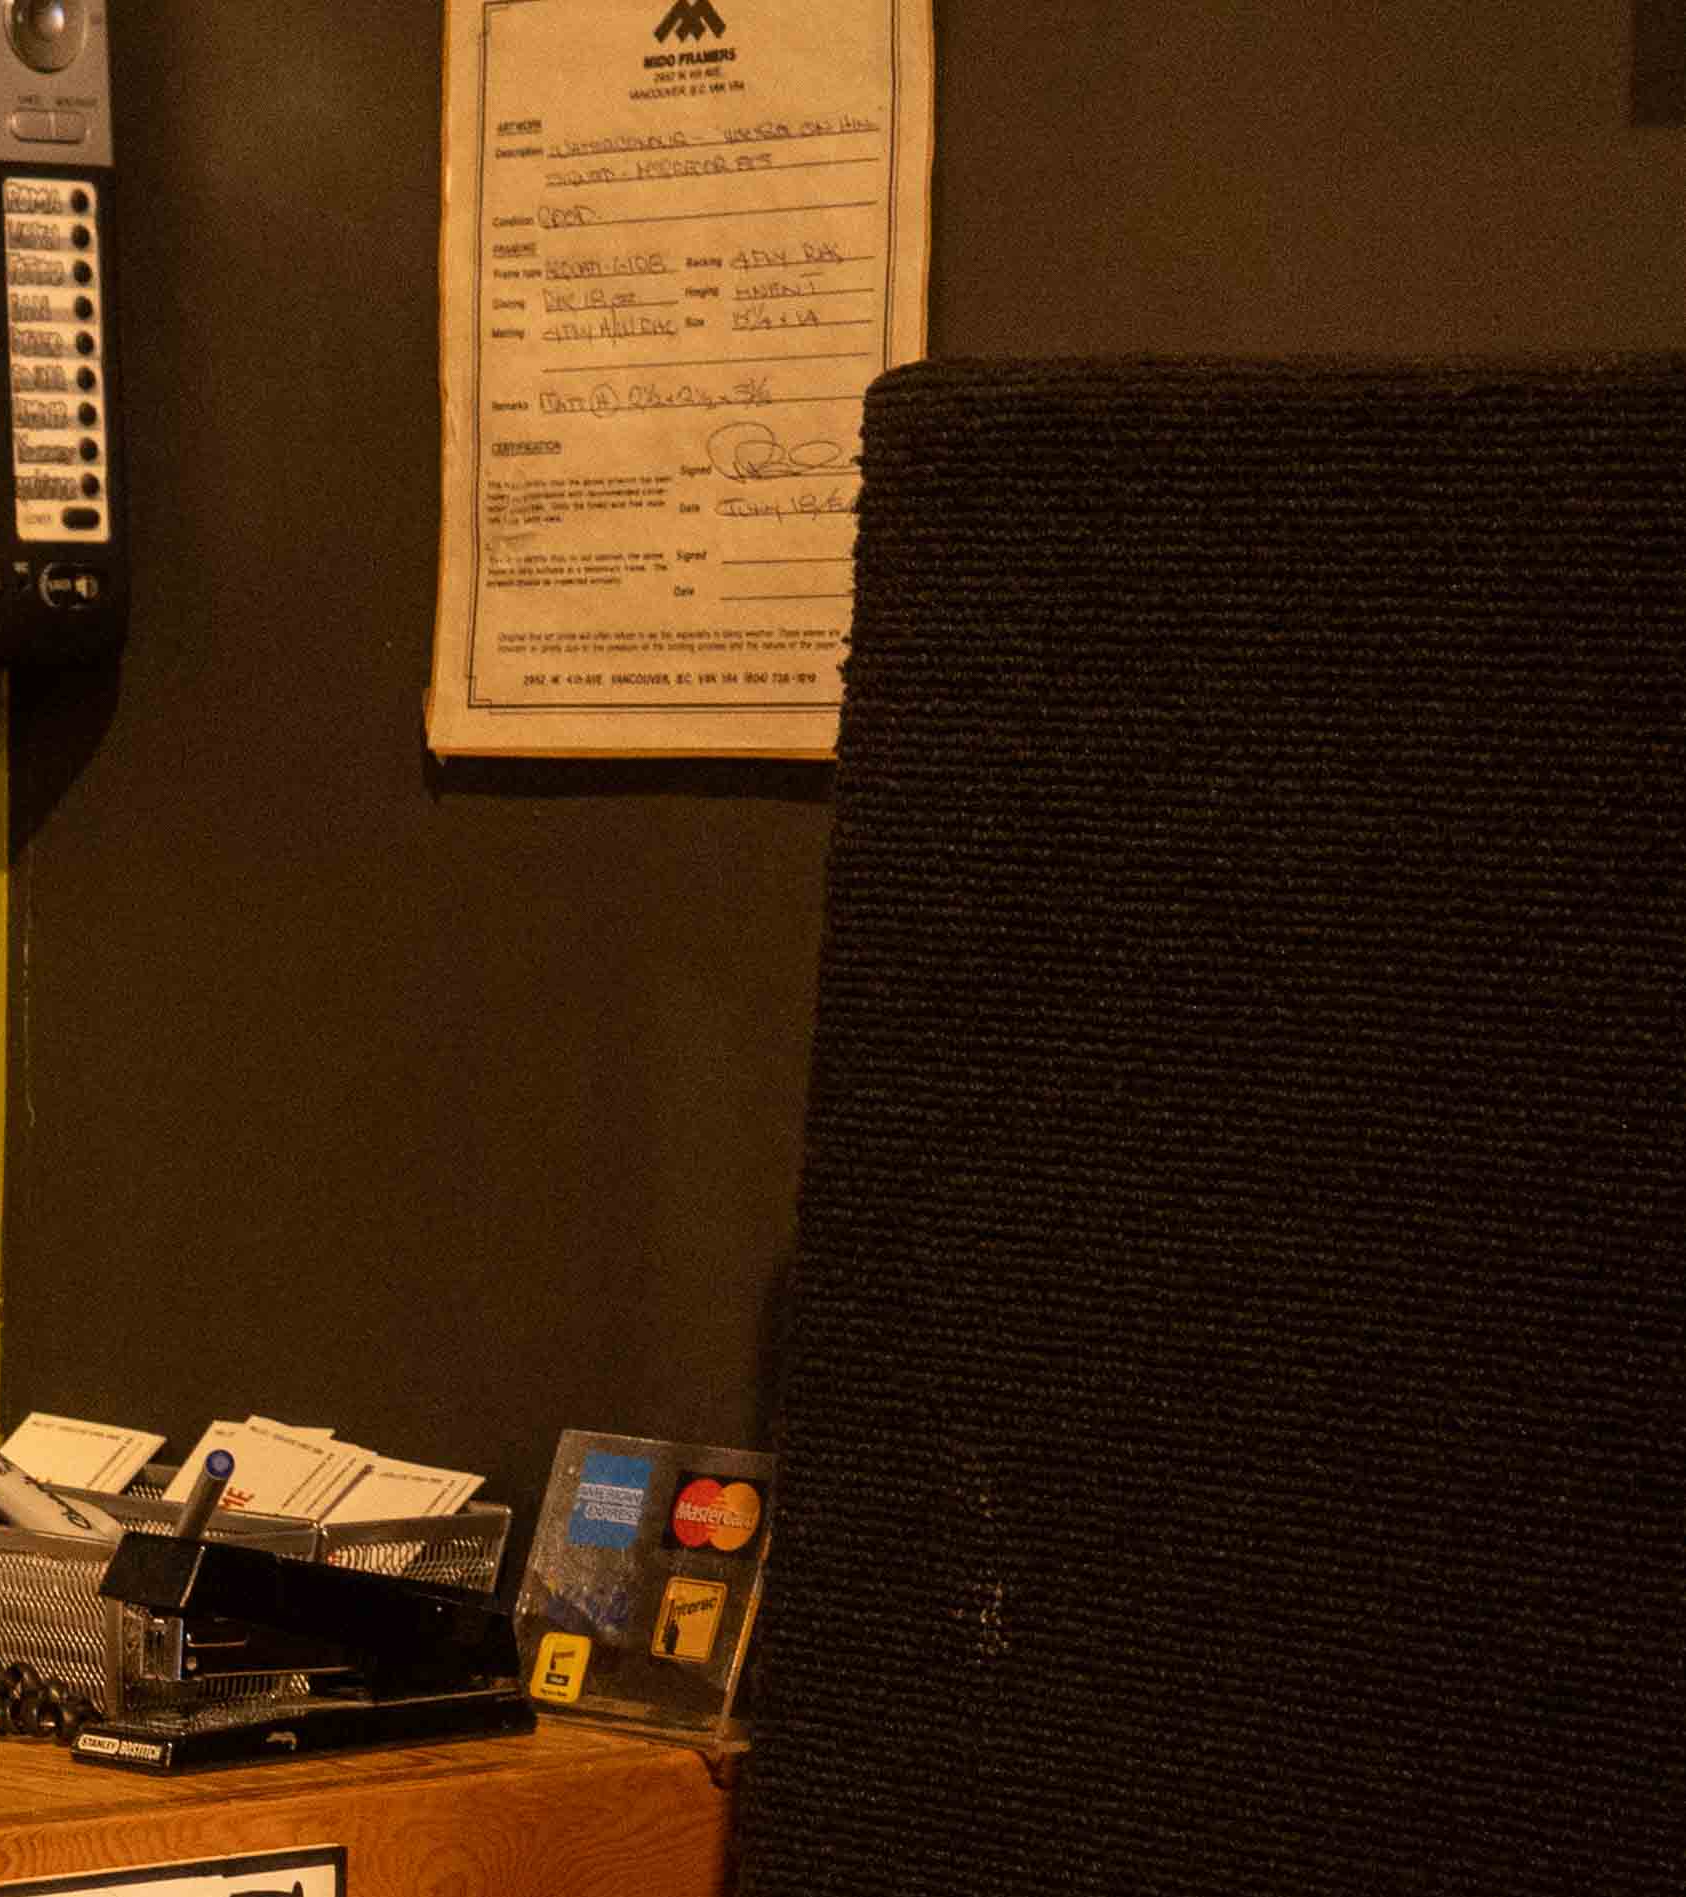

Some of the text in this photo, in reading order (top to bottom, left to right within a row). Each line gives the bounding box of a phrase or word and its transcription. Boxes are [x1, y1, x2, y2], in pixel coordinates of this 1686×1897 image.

[679, 47, 737, 66] FRAMERS
[680, 464, 712, 479] Signed
[678, 502, 701, 514] Date
[675, 549, 707, 564] Signed
[673, 585, 695, 598] Date
[675, 1500, 759, 1531] MasterCard
[82, 1736, 163, 1761] STANLEY BOSTITCH
